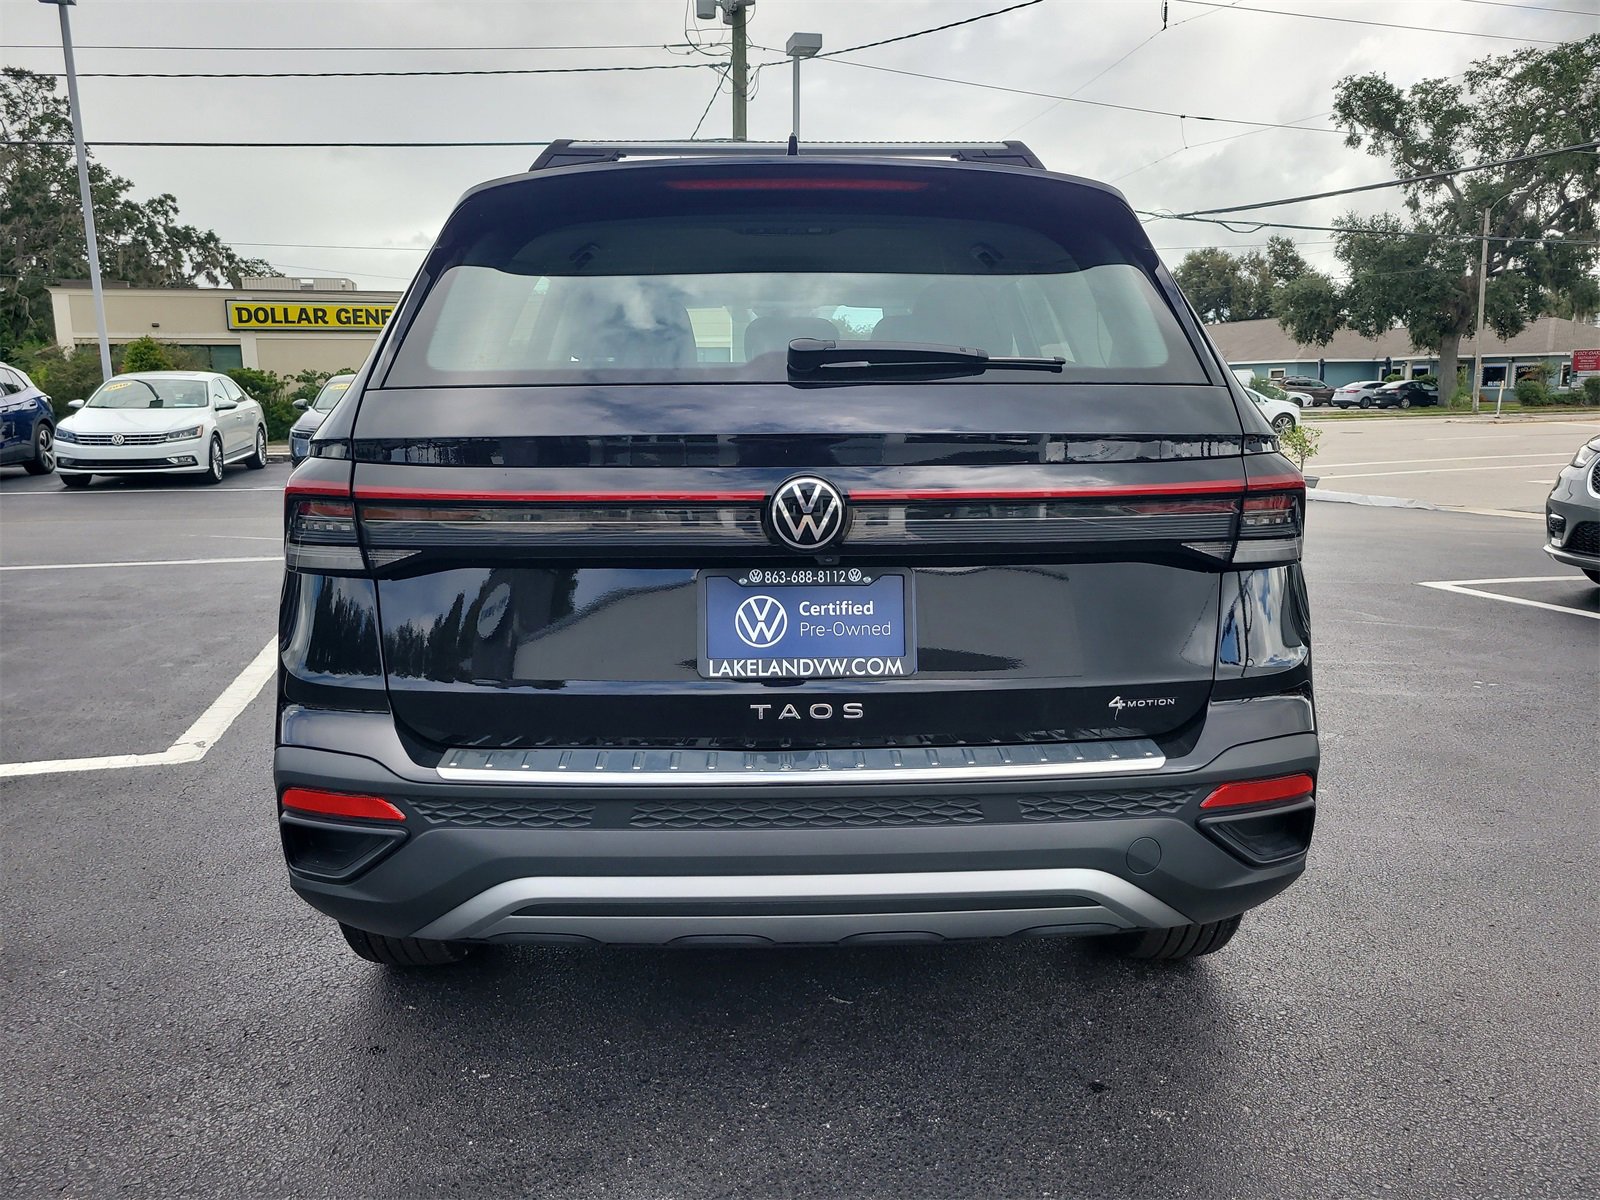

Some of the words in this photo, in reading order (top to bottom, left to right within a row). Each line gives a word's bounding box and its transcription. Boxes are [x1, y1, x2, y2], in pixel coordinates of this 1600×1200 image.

[235, 307, 329, 325] DOLLAR
[775, 481, 840, 544] VW
[764, 570, 846, 583] 863-688-8112
[799, 601, 874, 616] Certified
[737, 598, 786, 645] VW
[800, 621, 891, 637] Pre-Owned
[709, 657, 904, 677] LAKELANDVW.COM
[750, 703, 864, 720] TAOS
